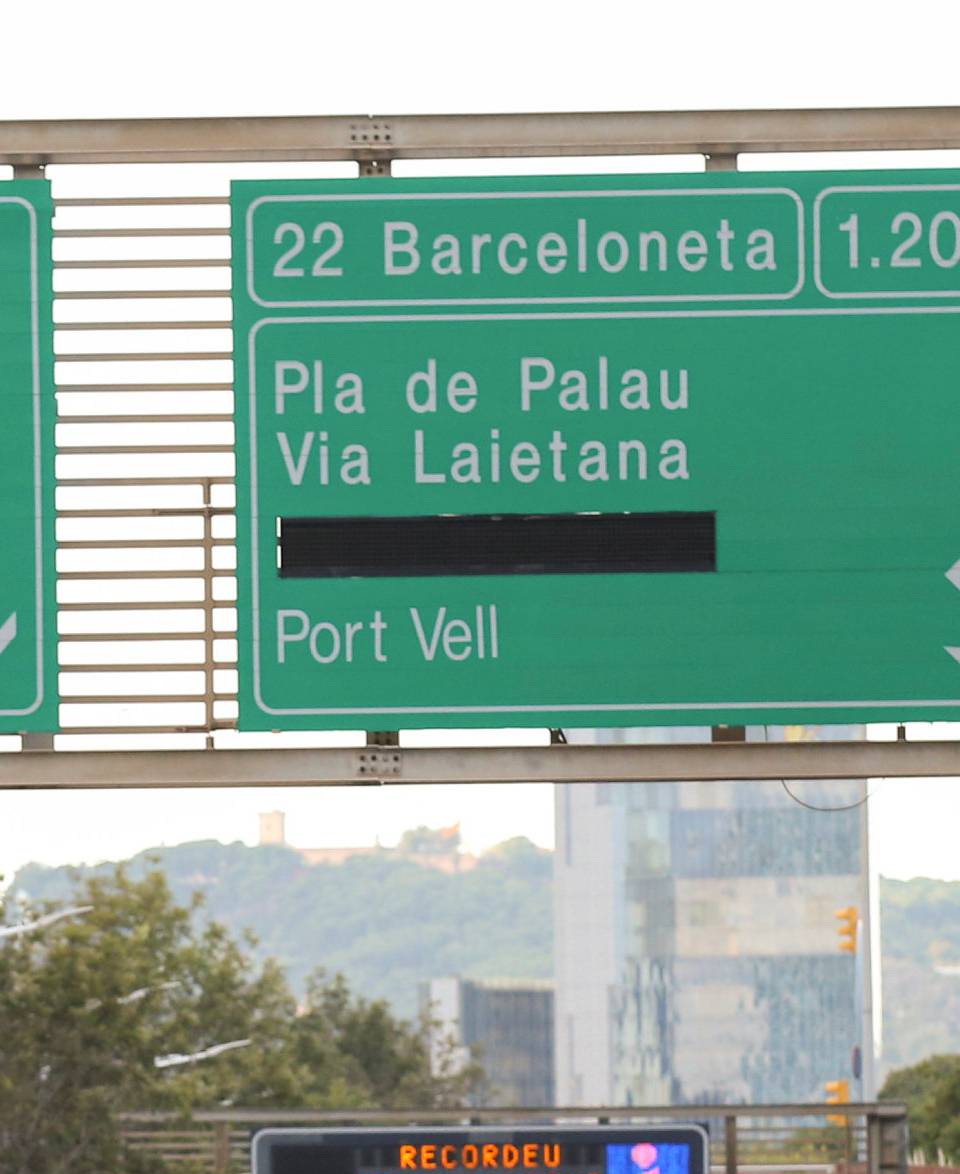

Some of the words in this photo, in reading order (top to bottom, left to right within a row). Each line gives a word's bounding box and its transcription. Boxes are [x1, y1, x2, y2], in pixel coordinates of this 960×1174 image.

[273, 221, 344, 277] 22
[384, 218, 777, 276] Barceloneta
[275, 360, 366, 414] Pla
[406, 358, 479, 414] de
[520, 356, 689, 411] Palau
[276, 430, 371, 486] Via
[414, 429, 689, 484] Laietana
[277, 609, 388, 664] Port
[410, 604, 498, 661] Vell
[399, 1143, 562, 1171] RECORDEU
